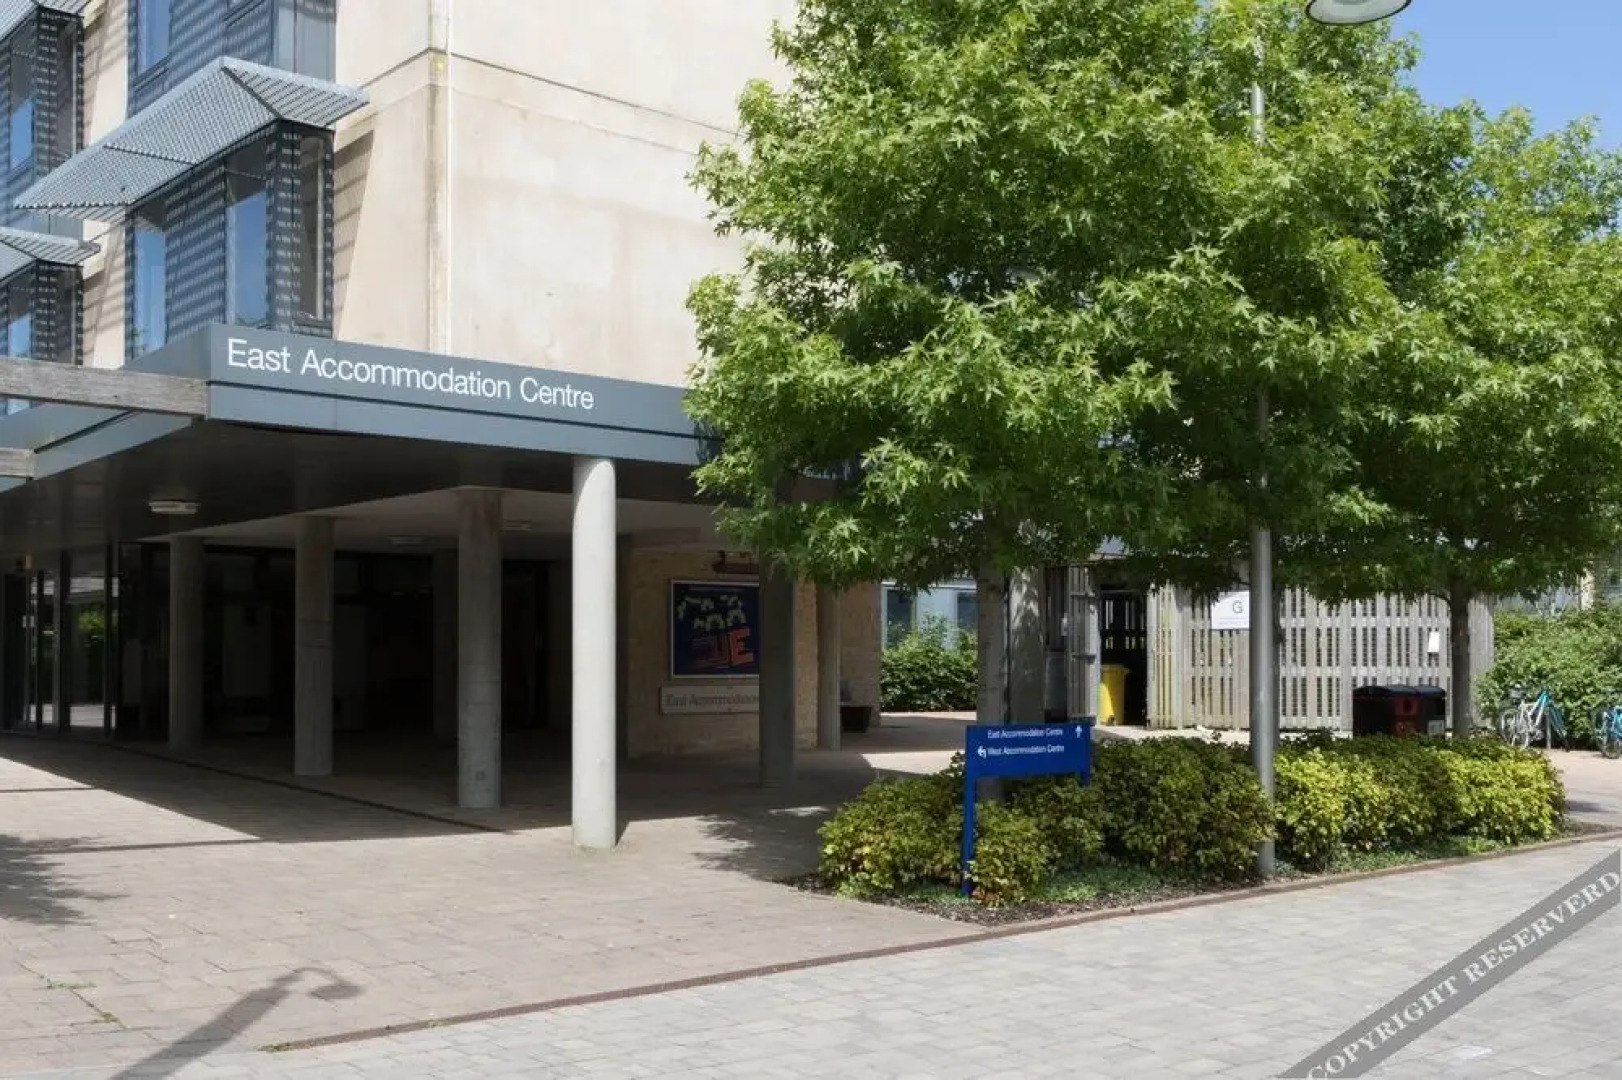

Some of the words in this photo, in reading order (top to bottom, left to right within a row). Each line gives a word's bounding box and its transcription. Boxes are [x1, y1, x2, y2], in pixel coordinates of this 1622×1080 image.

[227, 337, 291, 373] East
[300, 347, 511, 400] Accommodation
[520, 377, 595, 409] Centre
[1232, 599, 1244, 613] G
[987, 729, 1000, 739] East
[1001, 728, 1045, 739] Accommodation
[1046, 727, 1063, 736] Centre
[1003, 745, 1046, 755] Accommodation
[1047, 744, 1064, 753] Centre
